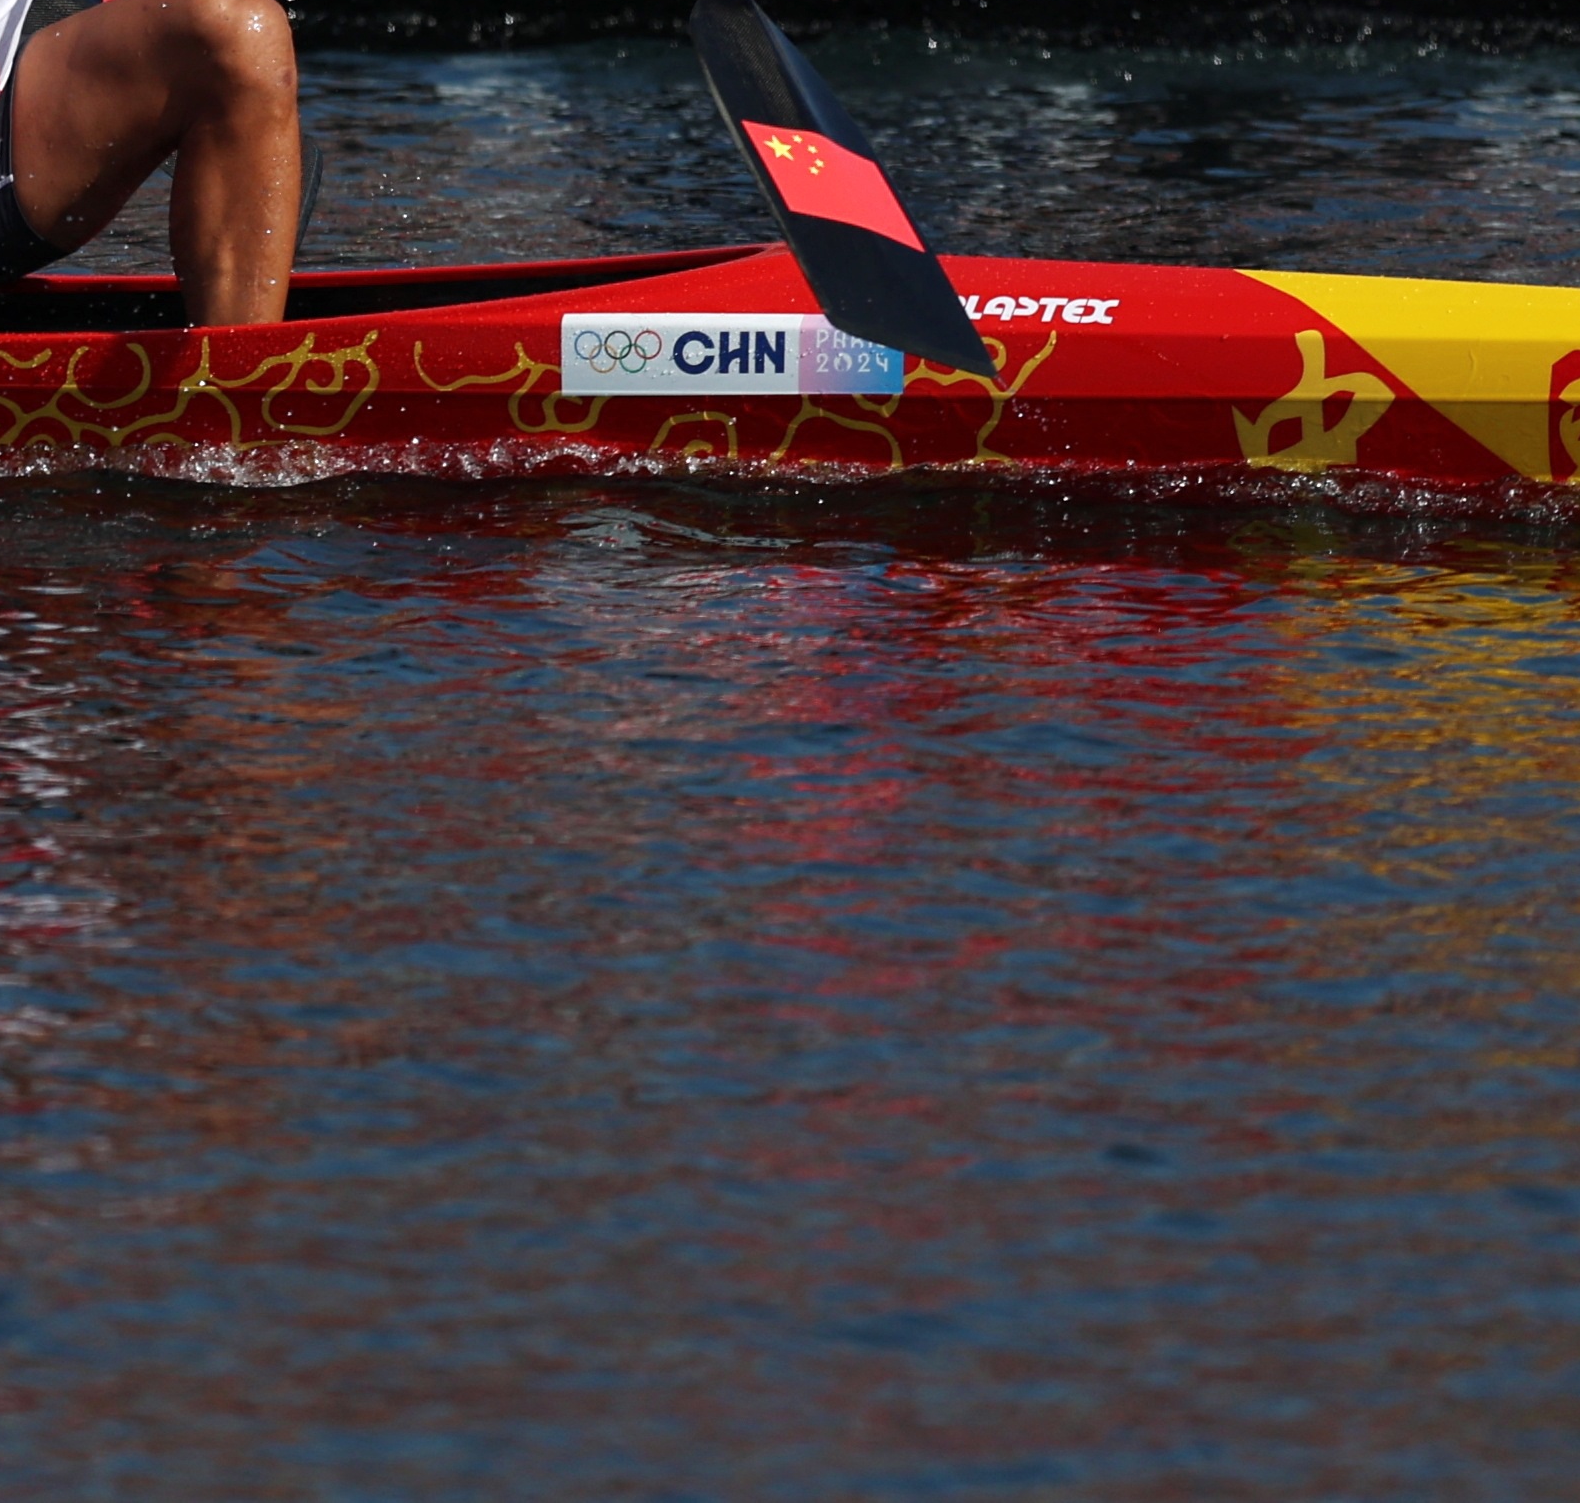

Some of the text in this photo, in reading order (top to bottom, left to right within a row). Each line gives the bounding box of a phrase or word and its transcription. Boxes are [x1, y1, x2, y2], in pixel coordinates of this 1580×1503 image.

[958, 294, 1120, 325] LASTEX
[672, 329, 786, 376] CHN
[815, 352, 889, 373] 2024
